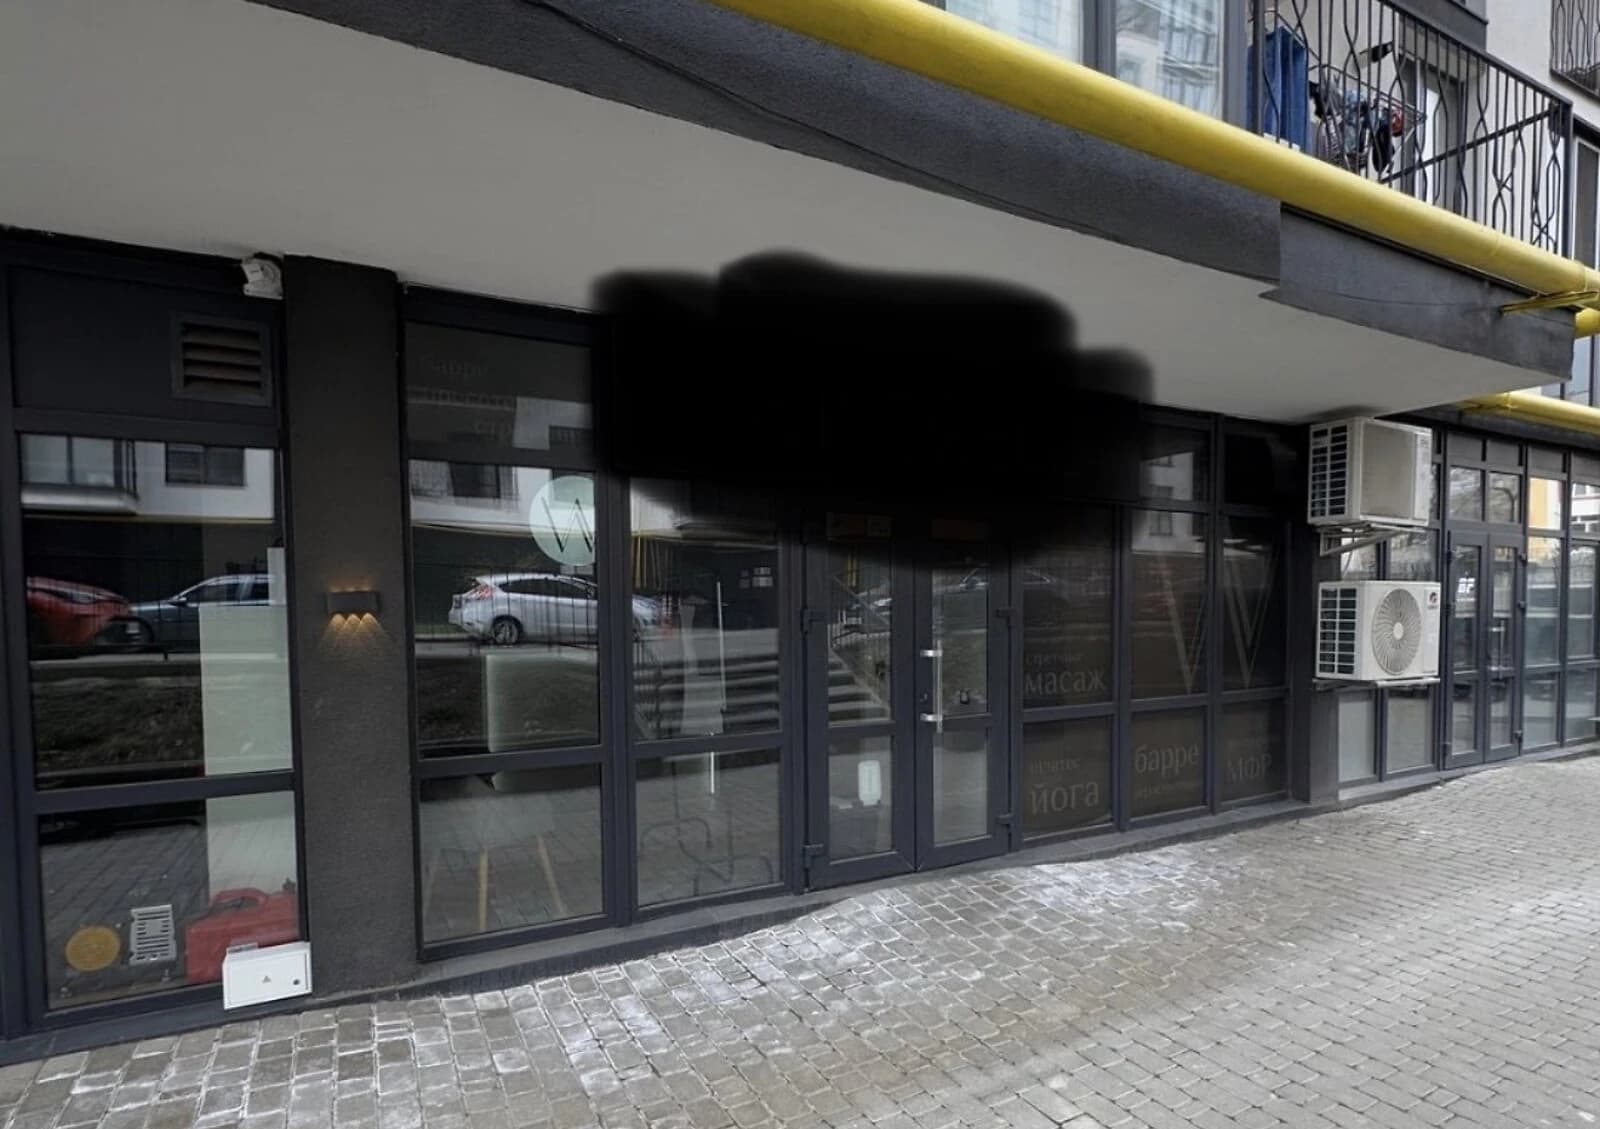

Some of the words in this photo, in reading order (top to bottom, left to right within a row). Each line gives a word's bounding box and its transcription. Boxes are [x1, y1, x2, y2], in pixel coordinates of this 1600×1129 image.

[1025, 669, 1105, 696] масаж
[1135, 743, 1200, 776] барре
[1031, 781, 1099, 816] йога
